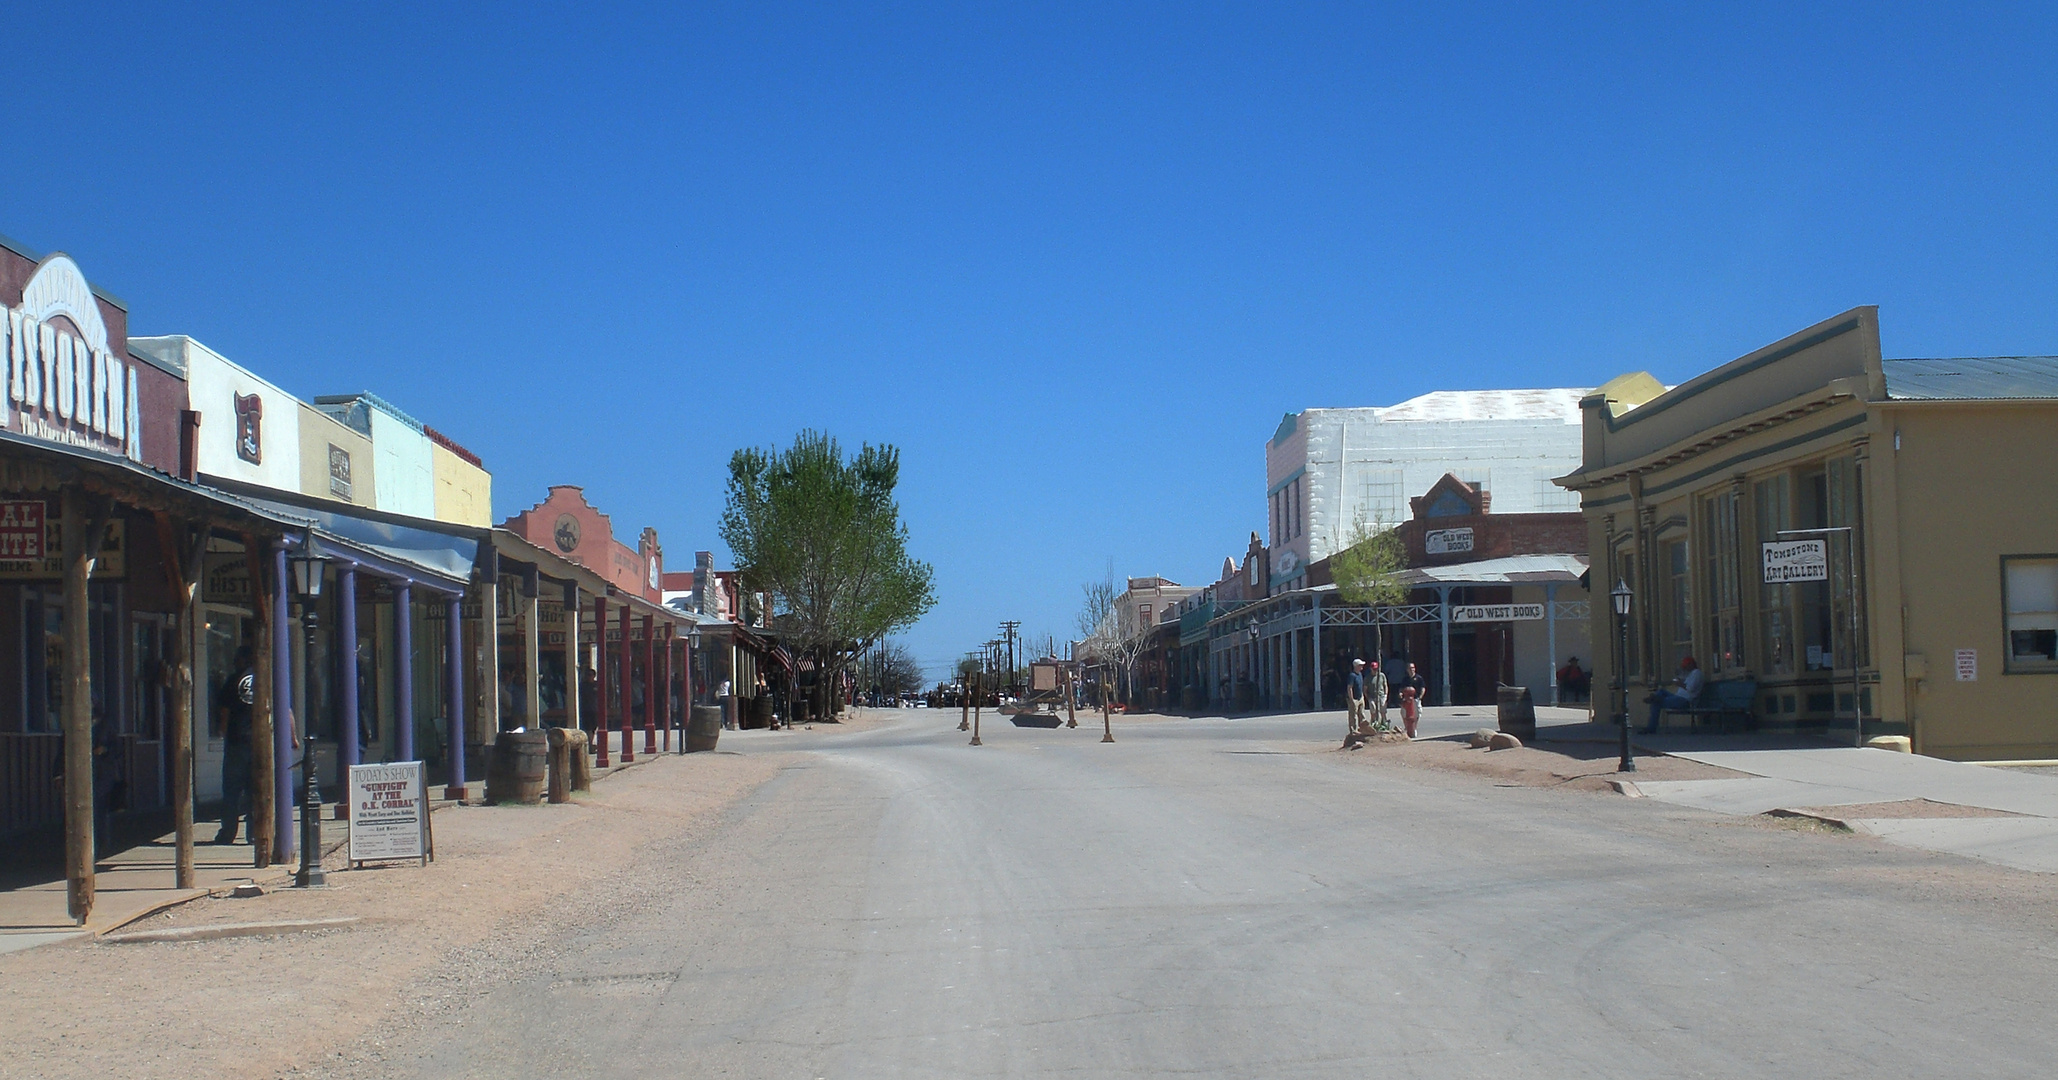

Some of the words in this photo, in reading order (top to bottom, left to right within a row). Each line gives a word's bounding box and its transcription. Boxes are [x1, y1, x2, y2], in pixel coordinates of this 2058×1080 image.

[1443, 534, 1455, 542] OLD
[1456, 533, 1473, 541] WEST
[1447, 541, 1469, 550] BOOKS
[1765, 543, 1819, 562] TOMBSTONE
[1766, 566, 1782, 581] ART
[1783, 564, 1825, 580] GALLERY
[1467, 608, 1484, 619] OLD
[1485, 607, 1509, 618] WEST
[1513, 606, 1540, 618] BOOKS
[354, 767, 389, 782] TODAY'S
[390, 766, 418, 780] SHOW
[372, 792, 384, 801] AT
[385, 791, 402, 800] THE
[362, 801, 379, 811] O.K.
